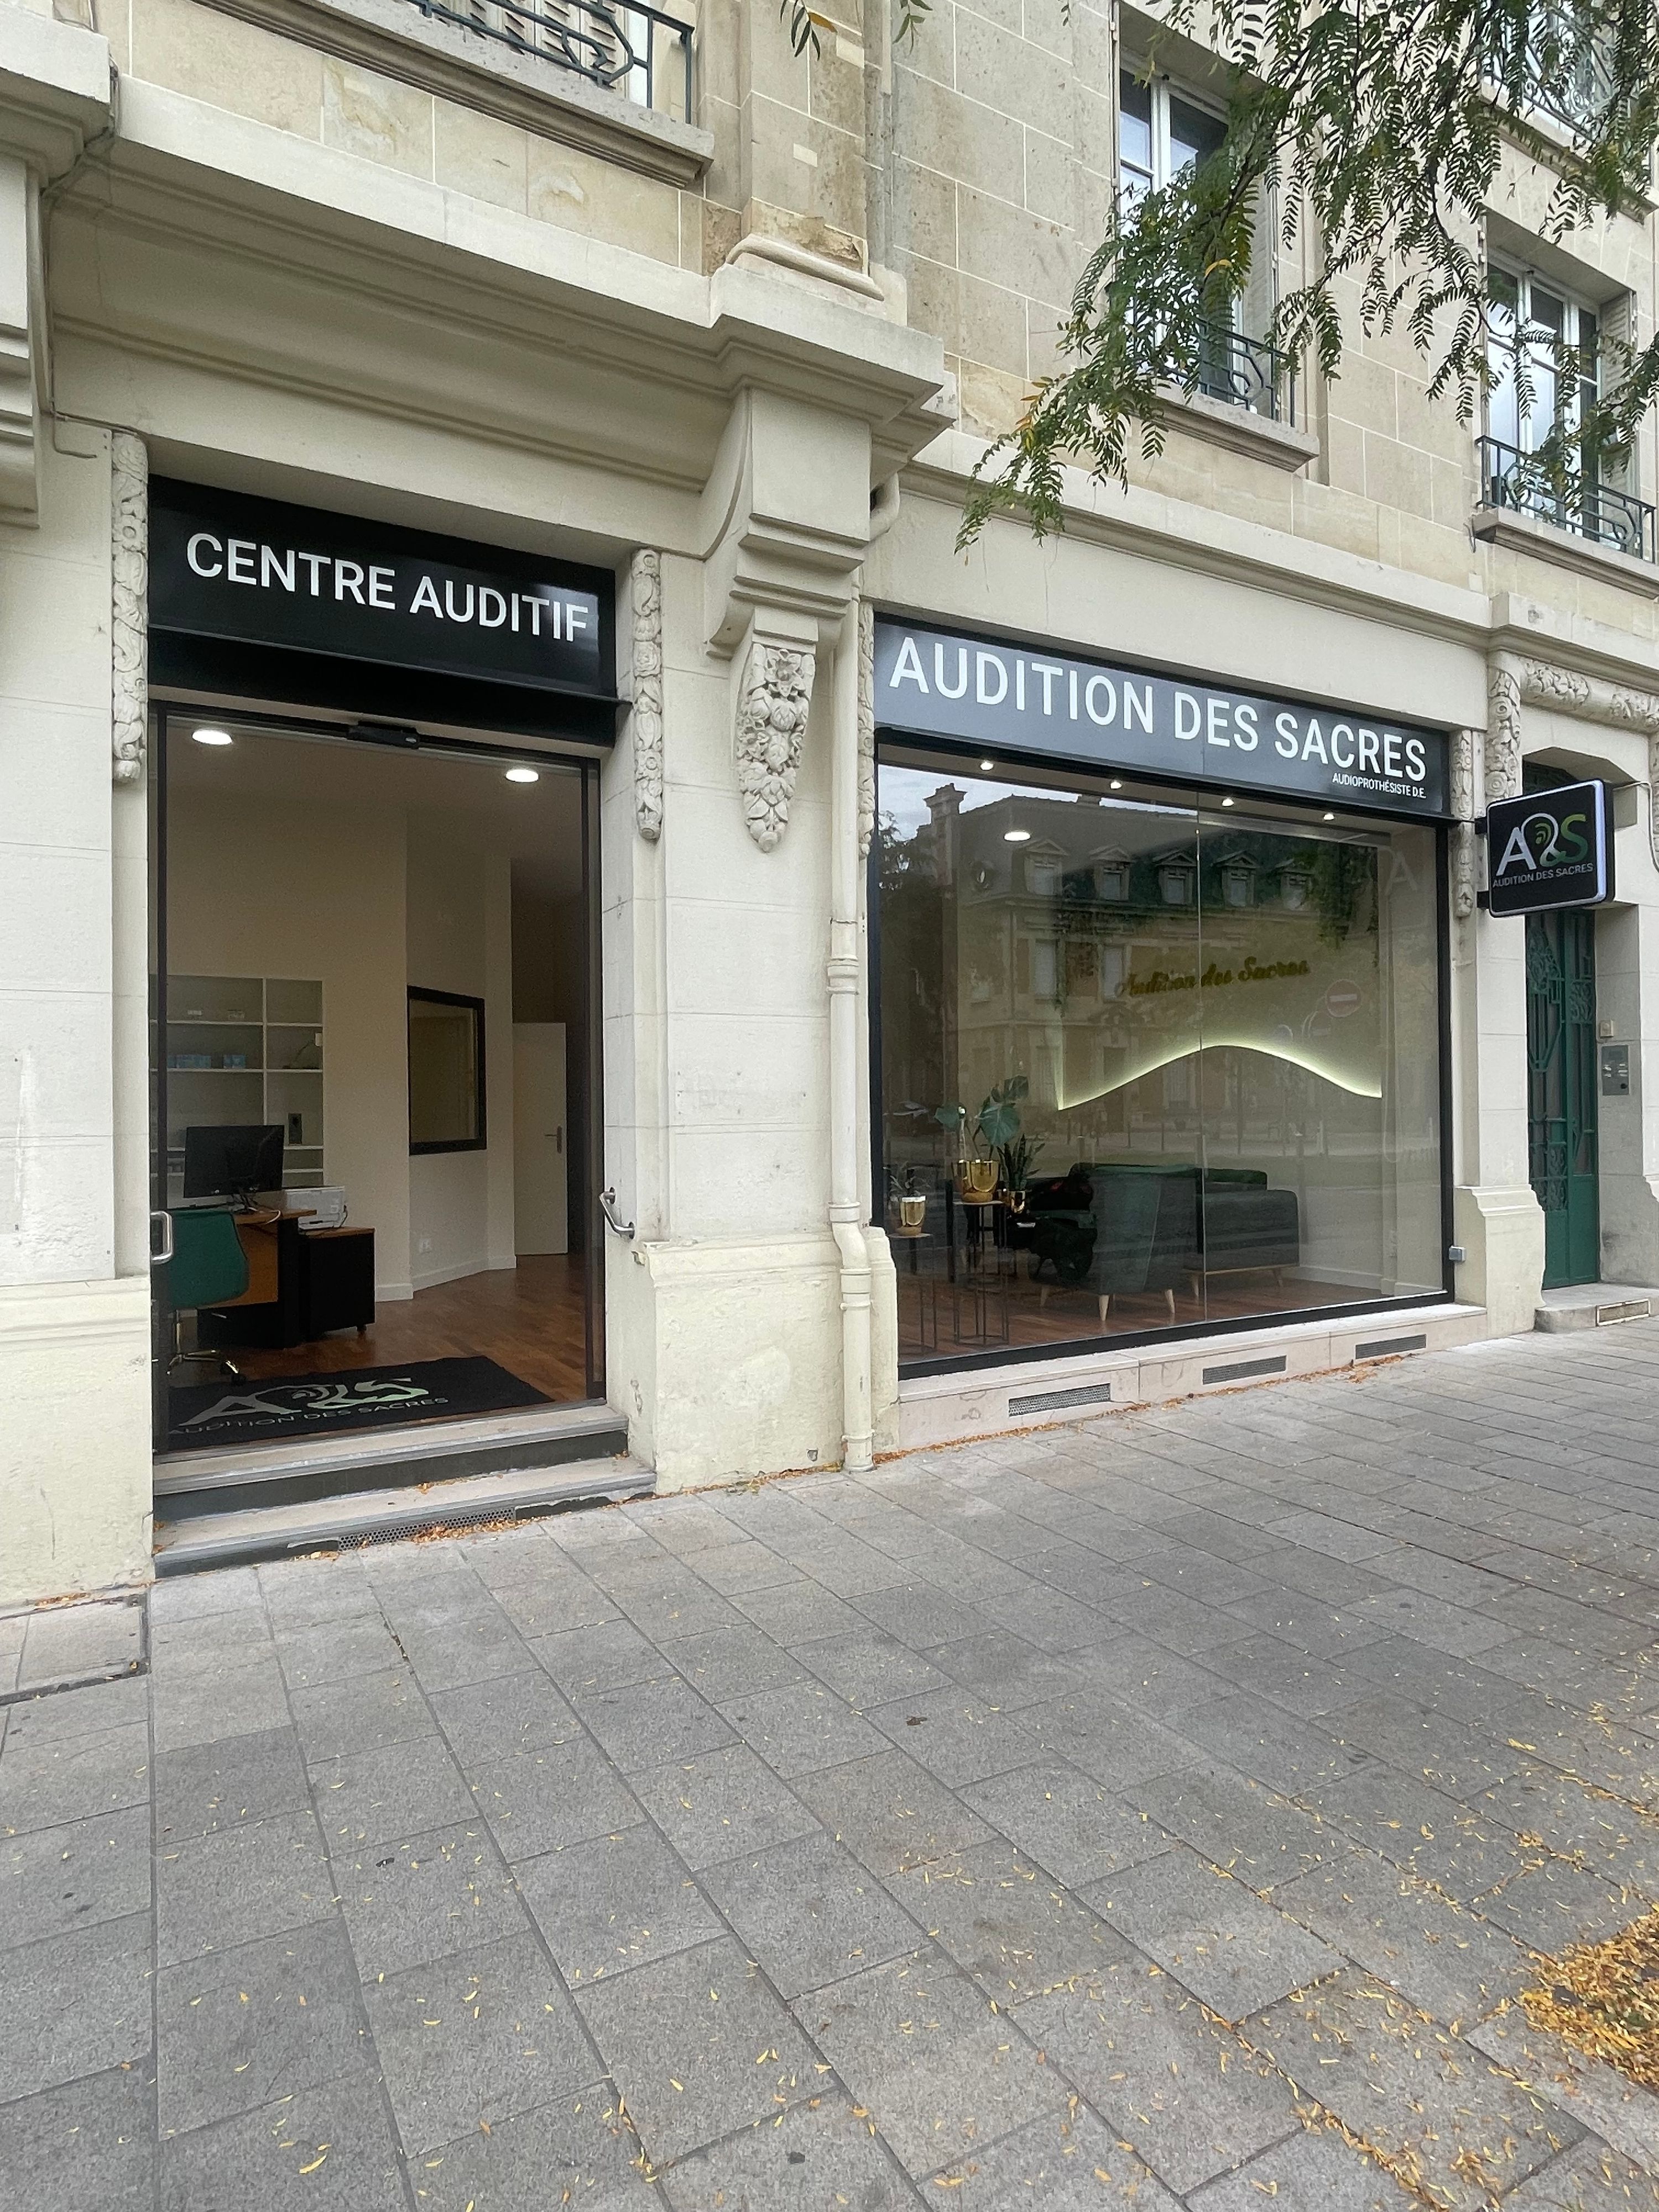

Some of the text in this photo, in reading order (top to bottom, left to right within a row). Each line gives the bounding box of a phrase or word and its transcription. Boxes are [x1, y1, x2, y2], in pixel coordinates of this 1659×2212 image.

[186, 532, 589, 642] CENTRE AUDITIF
[889, 637, 1426, 781] AUDITION DES SACRES
[1332, 772, 1412, 797] AUDIOPROTHÉSISTE
[1493, 863, 1594, 888] AUDITION DES SACRES
